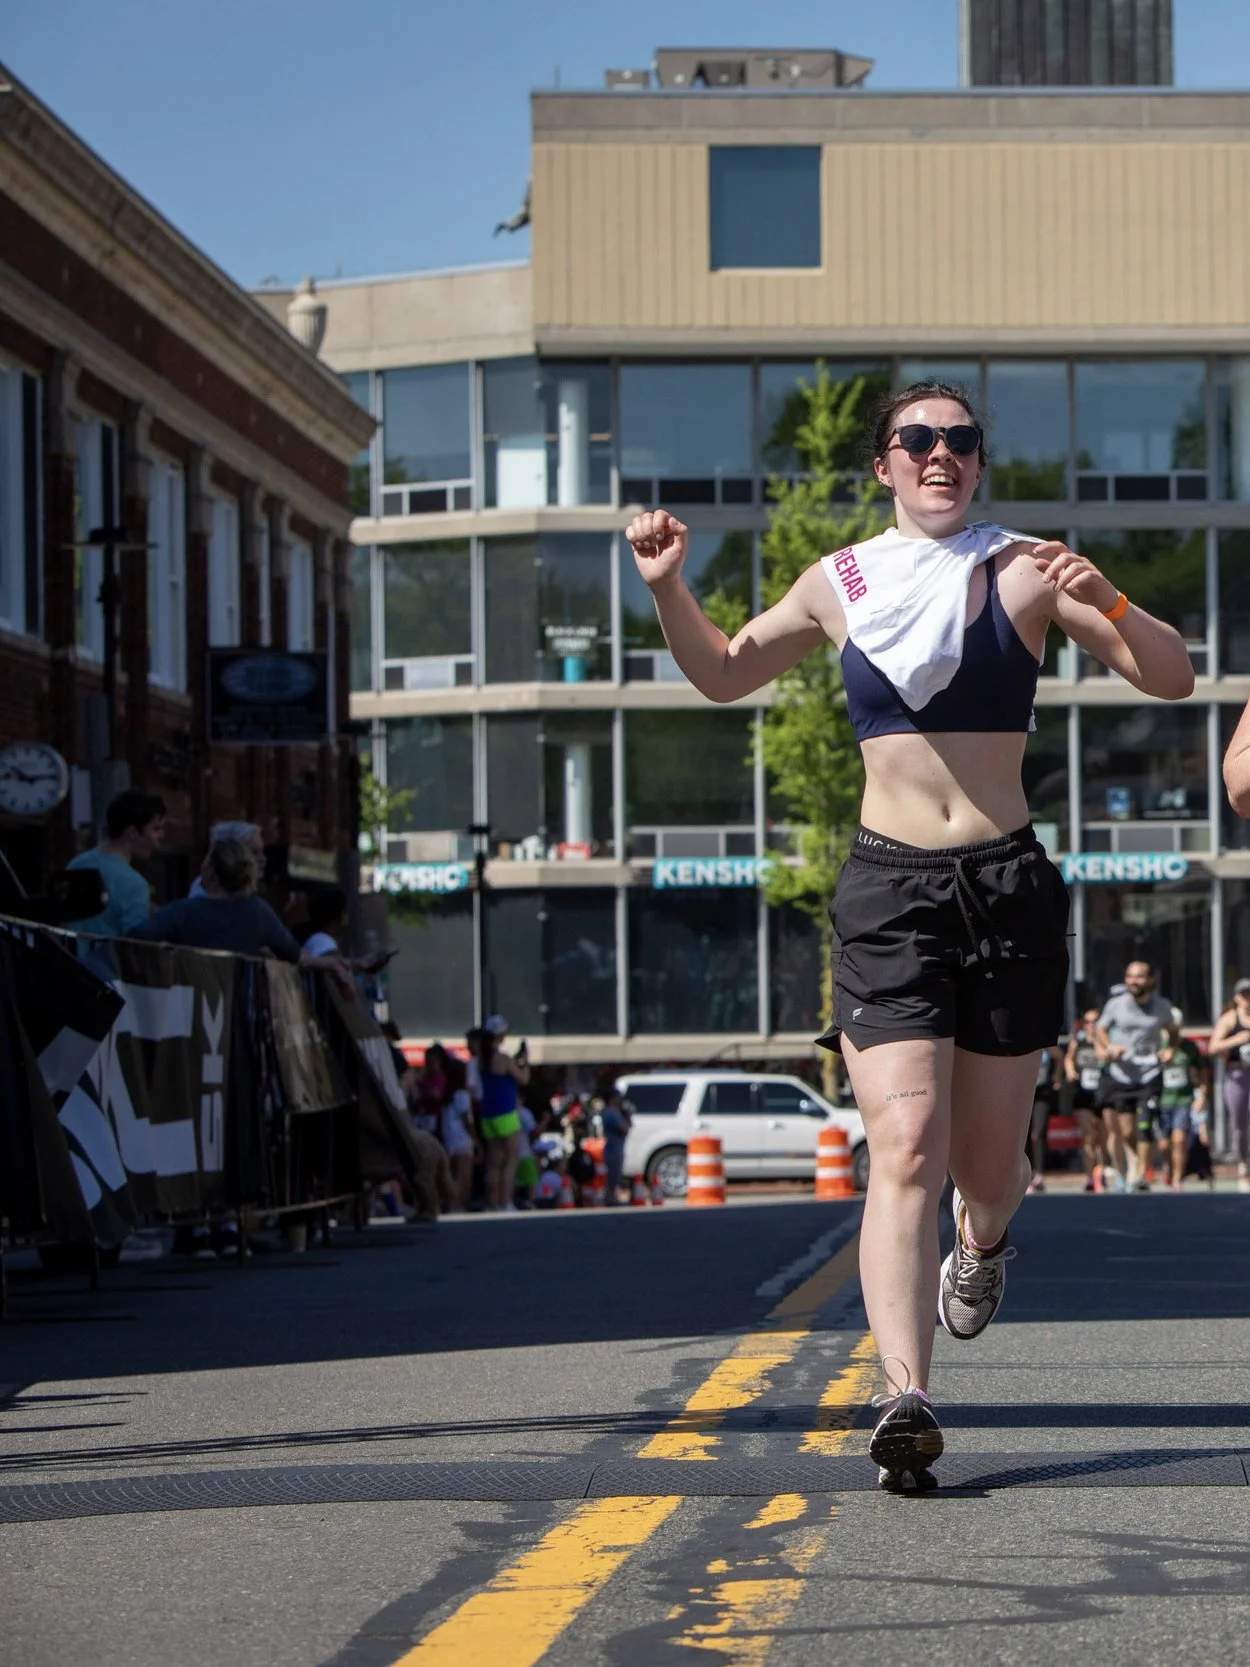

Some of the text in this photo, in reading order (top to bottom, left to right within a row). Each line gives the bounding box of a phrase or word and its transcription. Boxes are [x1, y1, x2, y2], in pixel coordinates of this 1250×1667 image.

[833, 547, 868, 603] REHAB
[1066, 855, 1185, 880] KENSHO
[910, 1088, 928, 1097] good
